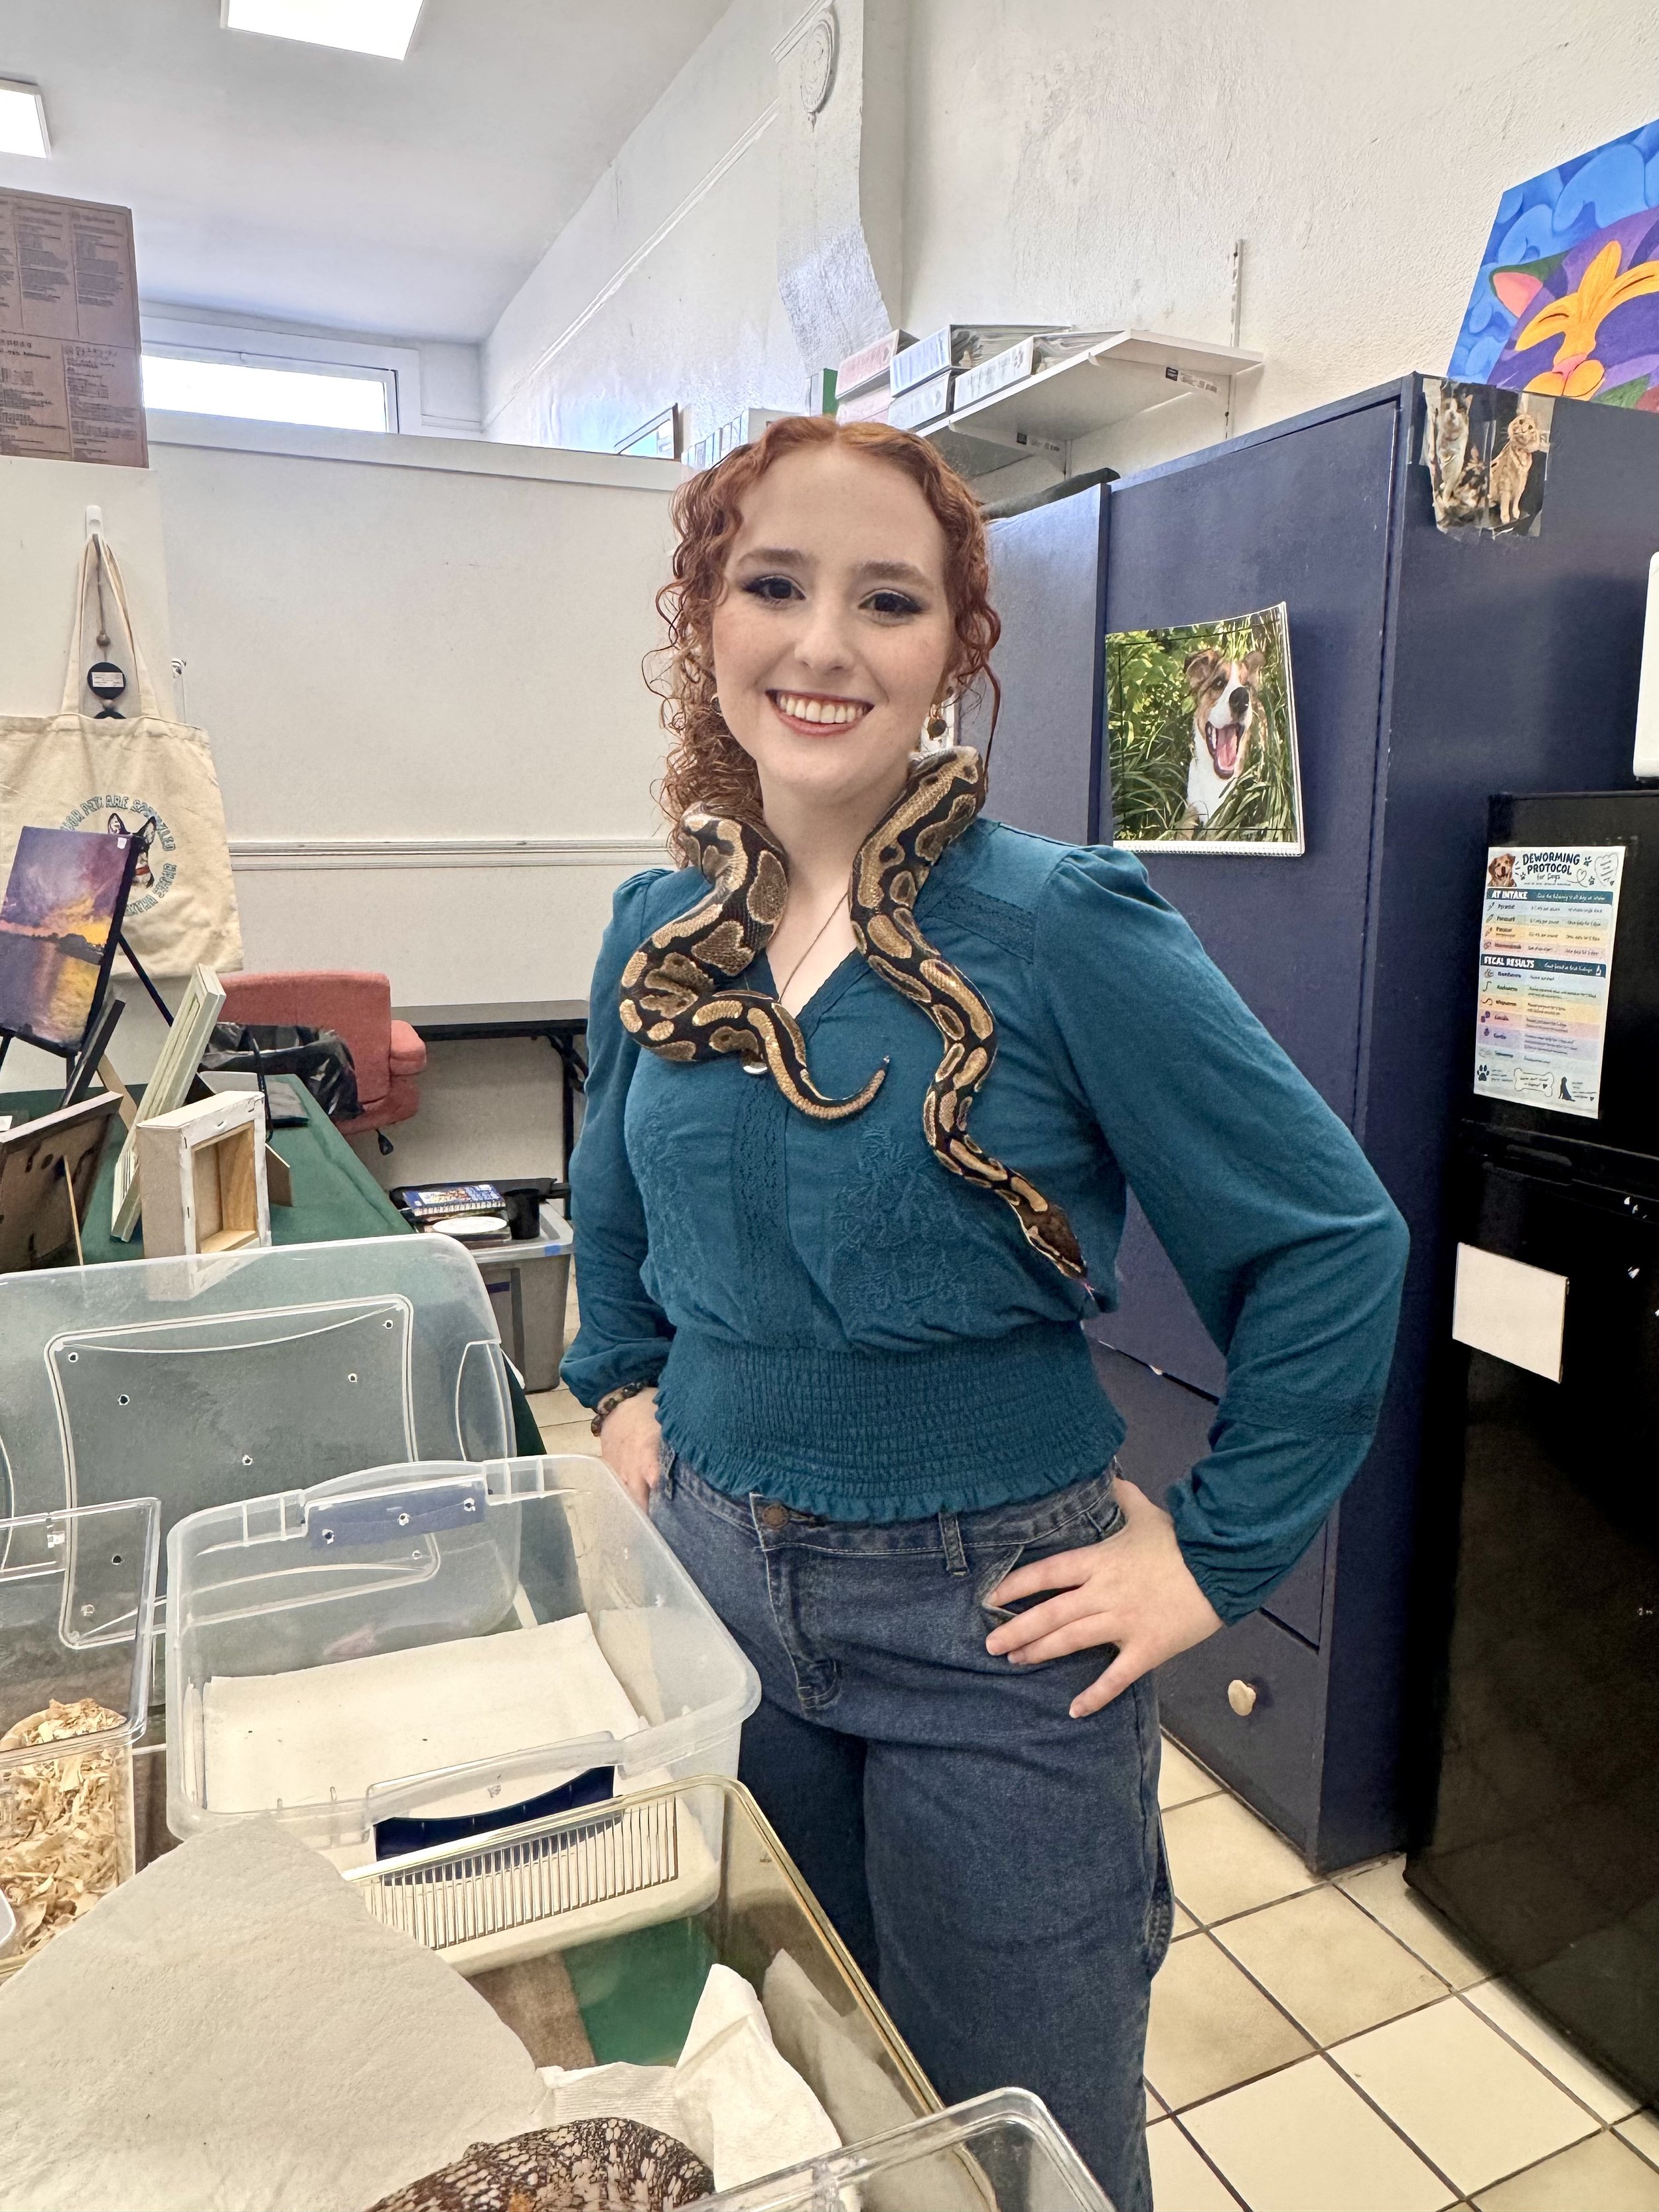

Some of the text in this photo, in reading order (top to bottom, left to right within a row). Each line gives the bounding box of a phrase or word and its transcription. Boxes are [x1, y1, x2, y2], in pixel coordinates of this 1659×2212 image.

[106, 795, 129, 810] ARE
[1522, 851, 1580, 865] DEWORMING
[1527, 863, 1572, 875] PROTOCOL
[1491, 890, 1528, 900] AT INTAKE
[1484, 956, 1505, 966] FECAL
[1506, 958, 1535, 968] RESULTS
